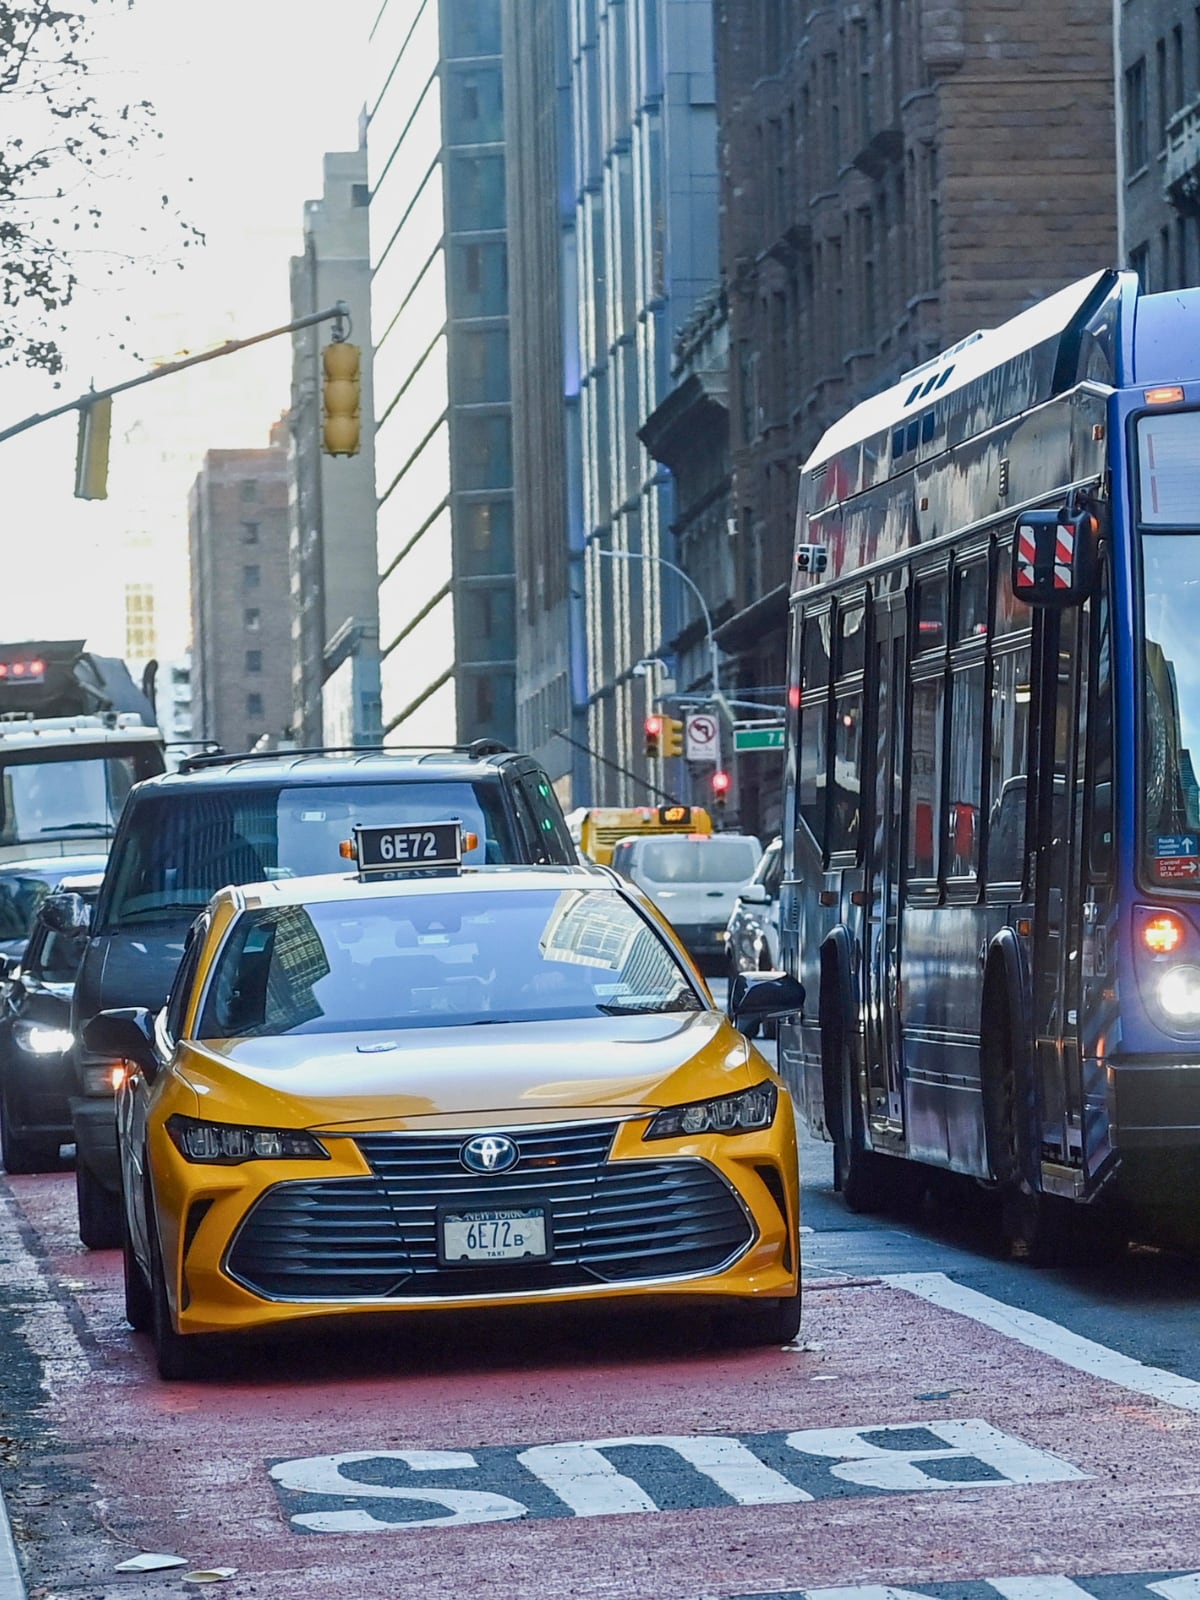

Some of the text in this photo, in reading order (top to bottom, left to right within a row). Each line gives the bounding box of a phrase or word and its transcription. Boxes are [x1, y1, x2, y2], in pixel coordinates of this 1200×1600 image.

[380, 832, 437, 860] 6E72
[487, 1250, 506, 1258] TAXI
[267, 1418, 1097, 1534] BUS
